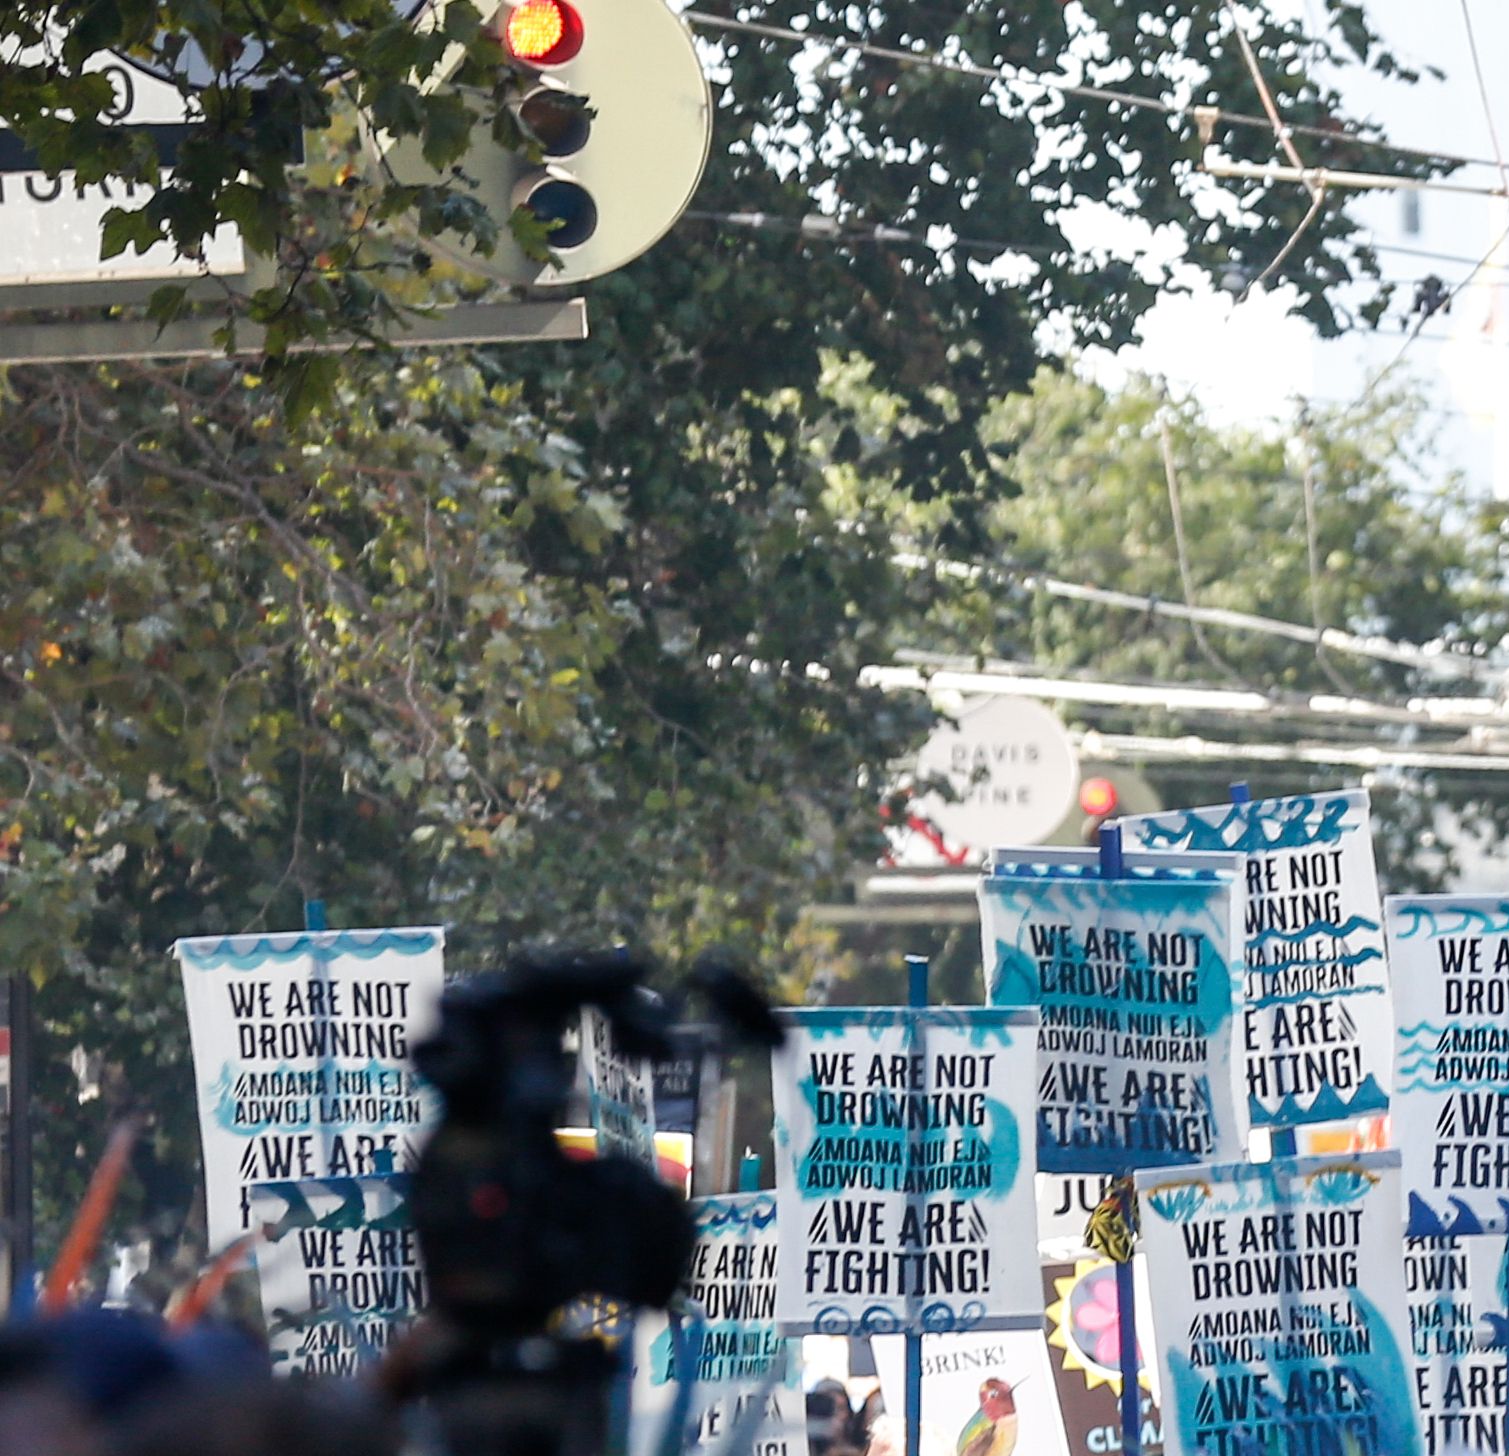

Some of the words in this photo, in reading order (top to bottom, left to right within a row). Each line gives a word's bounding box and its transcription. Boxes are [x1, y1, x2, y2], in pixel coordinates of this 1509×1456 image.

[1289, 850, 1344, 890] NOT
[1029, 924, 1073, 958] WE
[1084, 927, 1137, 965] ARE
[1148, 933, 1204, 968] NOT
[1438, 938, 1483, 974] WE
[228, 981, 274, 1018] WE
[286, 980, 343, 1017] ARE
[353, 982, 410, 1018] NOT
[1039, 961, 1198, 1005] DROWNING
[238, 1022, 407, 1060] DROWNING
[1050, 1005, 1121, 1032] MOANA
[1128, 1013, 1162, 1037] NUI
[1272, 1001, 1337, 1049] ARE
[1037, 1029, 1106, 1056] ADWOJ
[1113, 1038, 1208, 1063] LAMORAN
[249, 1071, 328, 1097] MOANA
[335, 1073, 371, 1098] NUI
[810, 1053, 855, 1086] WE
[867, 1055, 926, 1090] ARE
[934, 1055, 996, 1088] NOT
[1060, 1062, 1109, 1105] WE
[1121, 1068, 1187, 1111] ARE
[234, 1099, 311, 1125] ADWOJ
[319, 1098, 420, 1124] LAMORAN
[816, 1090, 986, 1131] DROWNING
[261, 1134, 315, 1179] WE
[824, 1137, 901, 1166] MOANA
[909, 1139, 945, 1168] NUI
[806, 1163, 885, 1191] ADWOJ
[893, 1164, 992, 1194] LAMORAN
[1054, 1177, 1111, 1216] JU
[833, 1200, 885, 1245] WE
[898, 1201, 966, 1247] ARE
[1183, 1220, 1229, 1259] WE
[1240, 1214, 1297, 1254] ARE
[1305, 1210, 1363, 1249] NOT
[299, 1230, 345, 1268] WE
[356, 1228, 416, 1267] ARE
[714, 1244, 755, 1281] ARE
[805, 1248, 990, 1296] FIGHTING!
[1192, 1251, 1358, 1302] DROWNING
[1204, 1307, 1282, 1338] MOANA
[1189, 1337, 1267, 1369] ADWOJ
[1274, 1328, 1372, 1362] LAMORAN
[1216, 1372, 1272, 1421] WE
[1285, 1366, 1349, 1417] ARE
[1443, 1365, 1508, 1409] ARE
